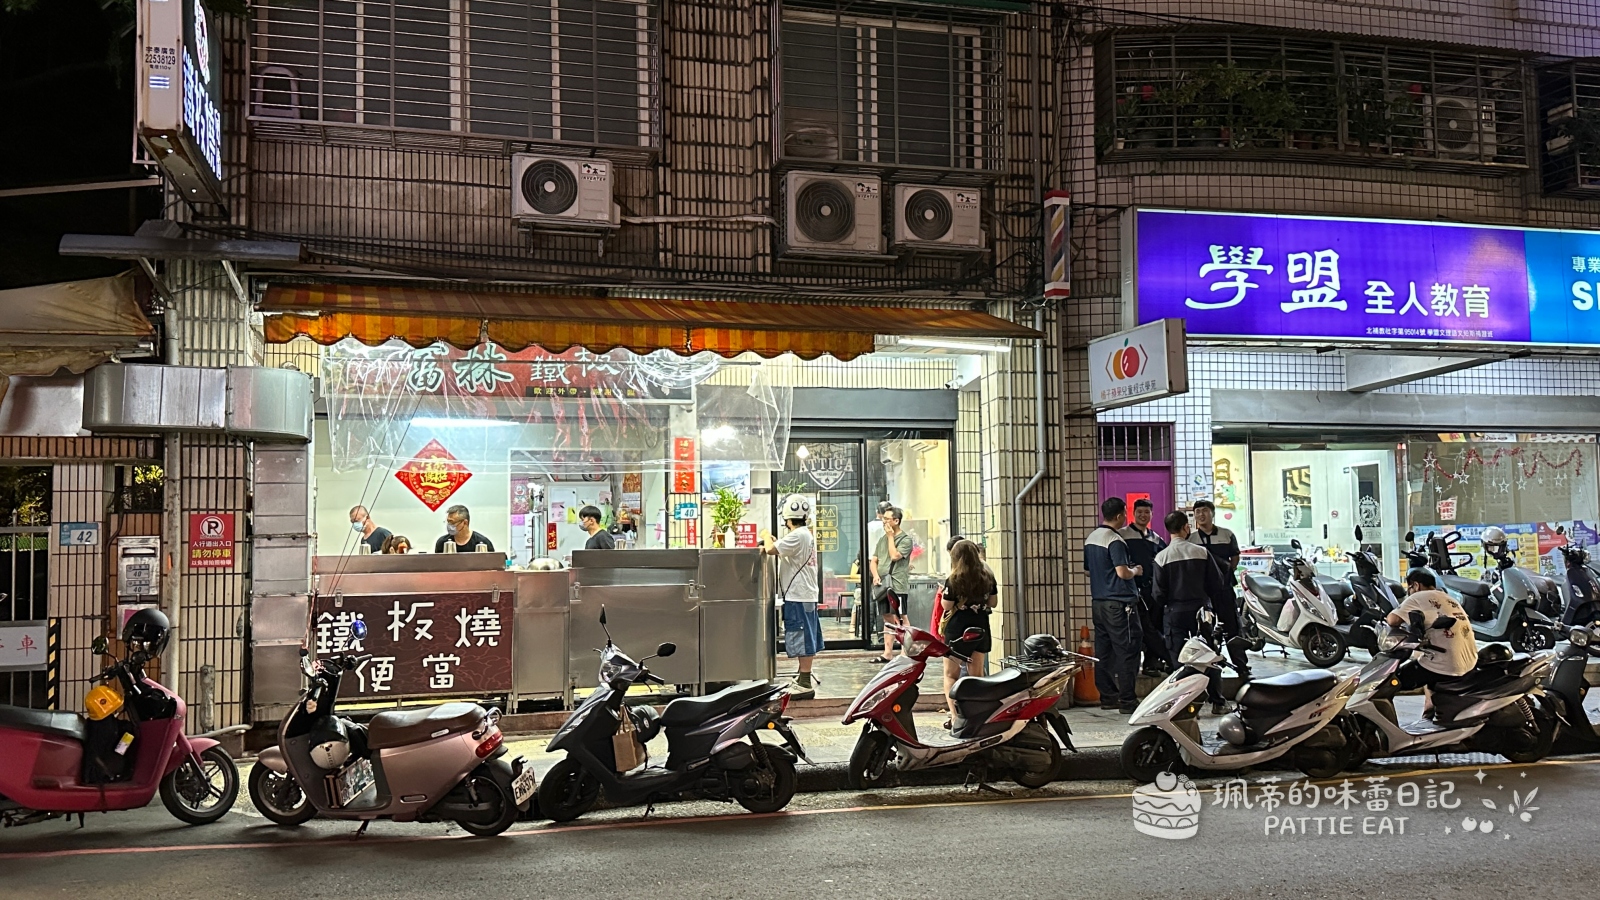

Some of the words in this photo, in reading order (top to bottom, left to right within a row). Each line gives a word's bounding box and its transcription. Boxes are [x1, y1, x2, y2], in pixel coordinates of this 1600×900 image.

[145, 54, 175, 65] 22538129
[1185, 244, 1348, 313] 學盟
[1364, 280, 1492, 319] 全人教育
[684, 508, 695, 518] 40
[77, 530, 93, 543] 42
[192, 540, 232, 548] 人行道出入口
[192, 548, 232, 558] 請勿停車
[316, 601, 502, 654] 鐵板燒
[355, 653, 461, 693] 便當
